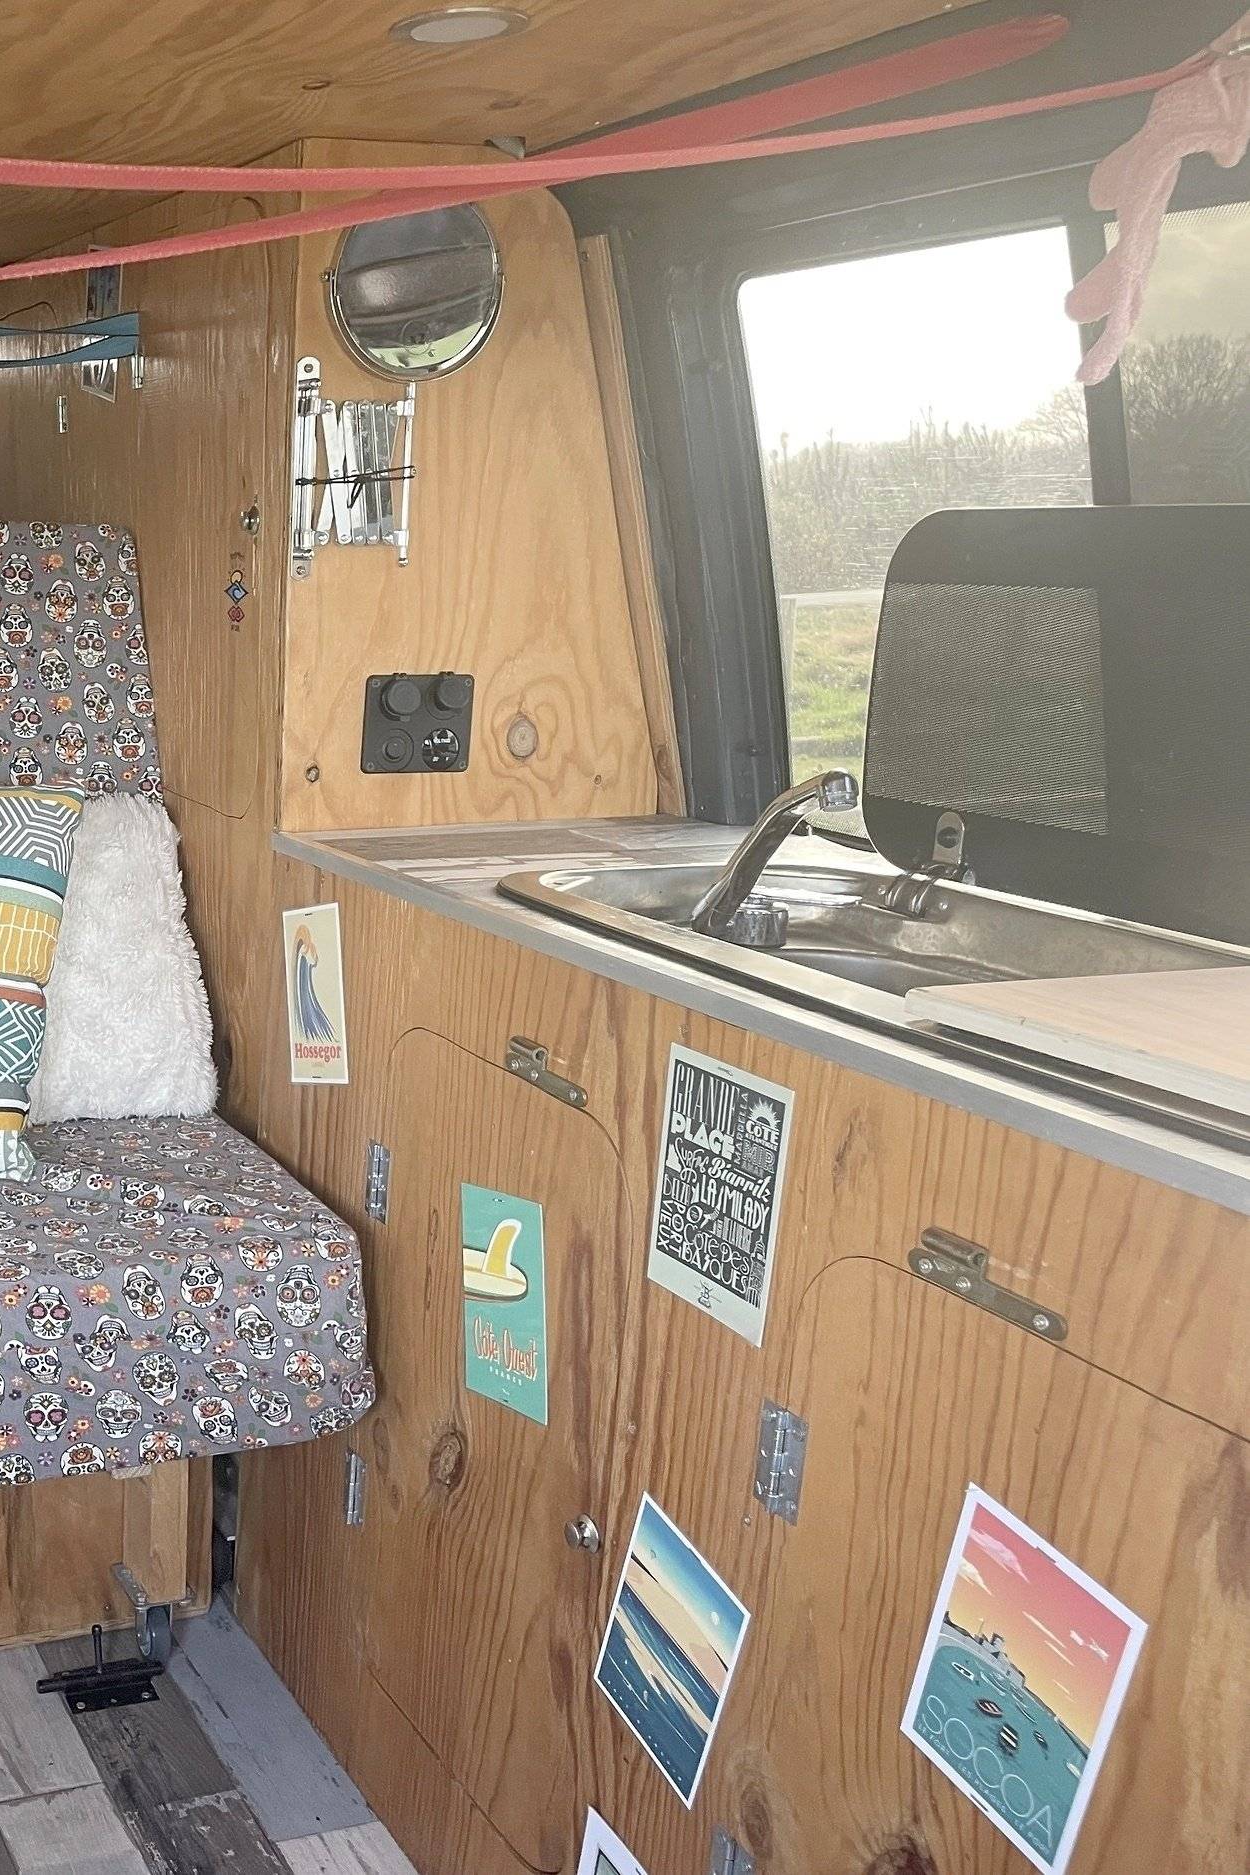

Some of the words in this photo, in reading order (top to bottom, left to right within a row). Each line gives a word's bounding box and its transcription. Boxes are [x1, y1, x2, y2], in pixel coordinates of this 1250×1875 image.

[294, 1043, 342, 1063] Hossegor
[673, 1065, 740, 1136] GRANDE
[670, 1111, 735, 1160] PLAGE
[701, 1174, 717, 1208] LA
[723, 1187, 769, 1234] MILADY
[708, 1158, 771, 1202] Biarritz
[658, 1200, 675, 1251] VIEUX
[669, 1200, 687, 1258] PORT
[682, 1243, 747, 1294] BASQUES
[921, 1694, 1053, 1849] SOCOA
